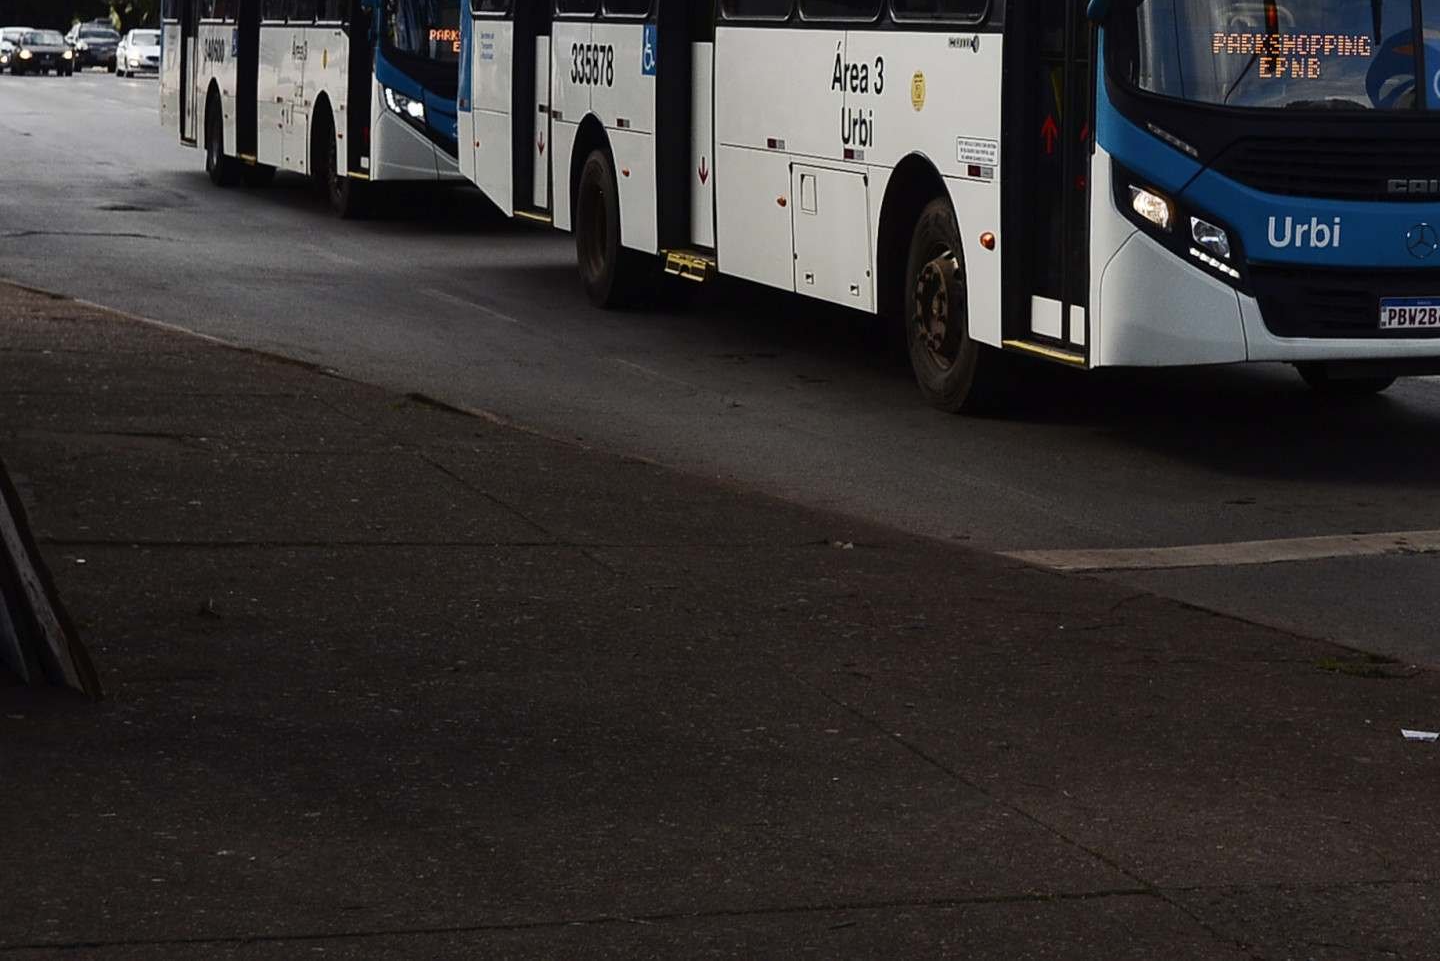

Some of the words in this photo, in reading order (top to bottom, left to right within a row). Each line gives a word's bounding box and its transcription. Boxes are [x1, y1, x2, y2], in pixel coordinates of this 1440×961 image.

[1213, 32, 1371, 56] PARKSHOPPING
[570, 42, 614, 88] 335878
[831, 40, 869, 94] Área
[874, 55, 884, 95] 3
[1259, 56, 1321, 79] EPNB
[841, 106, 873, 147] Urbi
[1267, 216, 1342, 248] Urbi
